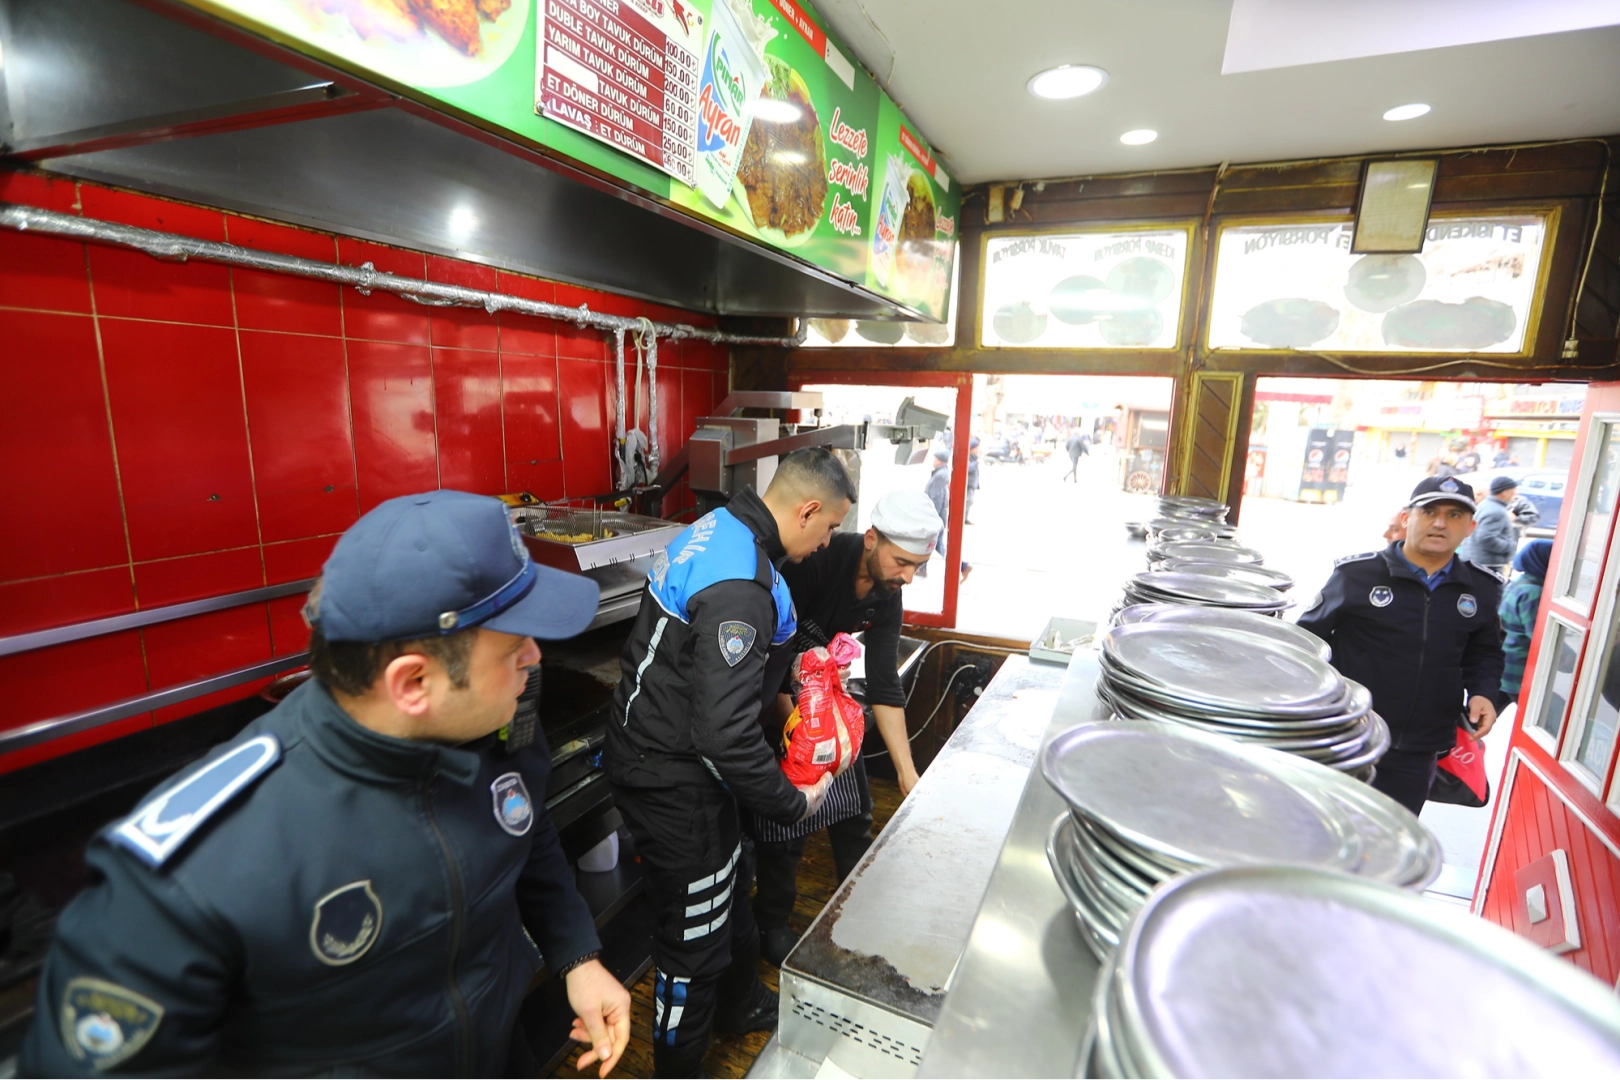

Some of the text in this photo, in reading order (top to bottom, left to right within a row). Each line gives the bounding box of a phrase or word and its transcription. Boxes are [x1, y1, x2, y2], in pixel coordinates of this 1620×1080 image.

[549, 1, 649, 79] DUBLE TAVUK DÜRÜM
[549, 24, 647, 98] YARIM TAVUK DÜRÜM
[580, 0, 600, 24] BOY
[602, 14, 631, 46] TAVUK
[633, 37, 662, 69] DÜRÜM
[548, 73, 633, 131] ET DÖNER DÜRÜM
[599, 80, 660, 126] TAVUK DÜRÜM
[699, 83, 741, 147] Ayran
[600, 123, 612, 138] ET
[614, 129, 646, 155] DÜRÜM
[830, 107, 867, 159] Lezzete
[829, 158, 868, 202] serinlik
